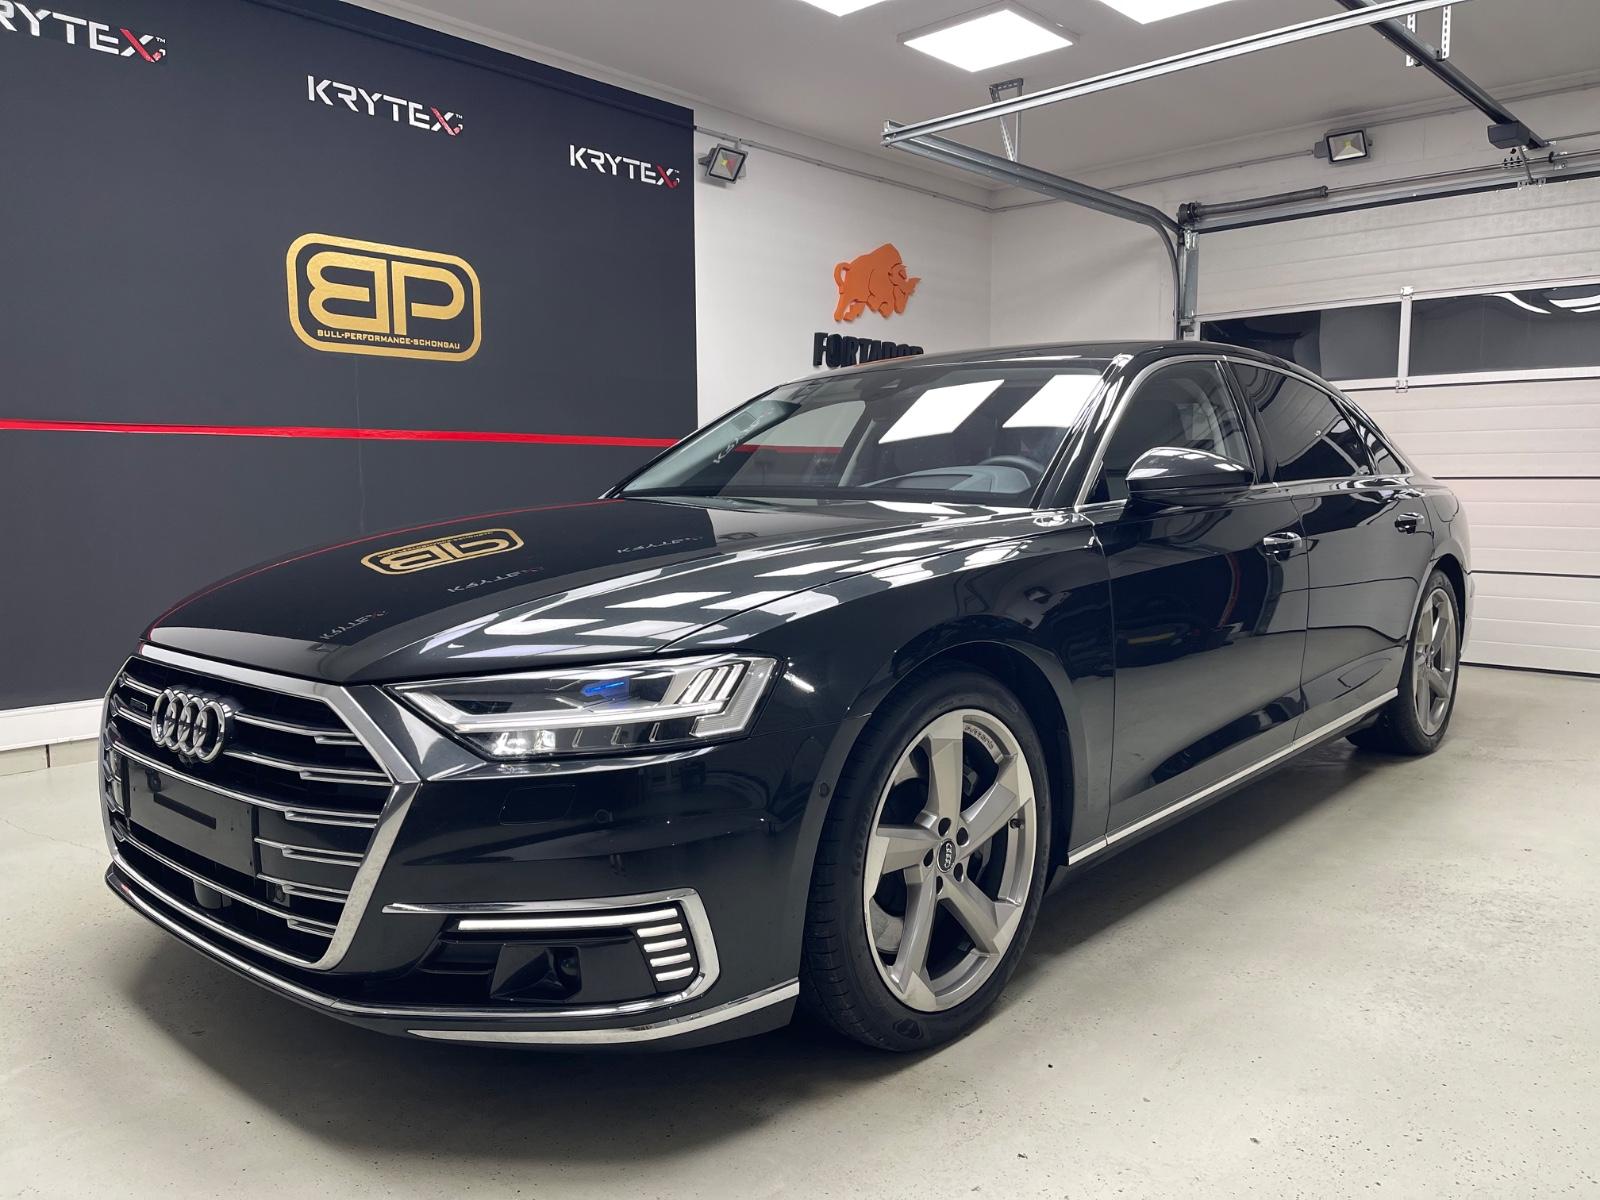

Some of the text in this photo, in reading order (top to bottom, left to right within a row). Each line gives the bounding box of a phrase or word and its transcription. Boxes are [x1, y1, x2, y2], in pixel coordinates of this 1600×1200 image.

[308, 75, 461, 136] KRYTEX
[569, 144, 679, 189] KRYTEX
[813, 332, 924, 368] FORTAD
